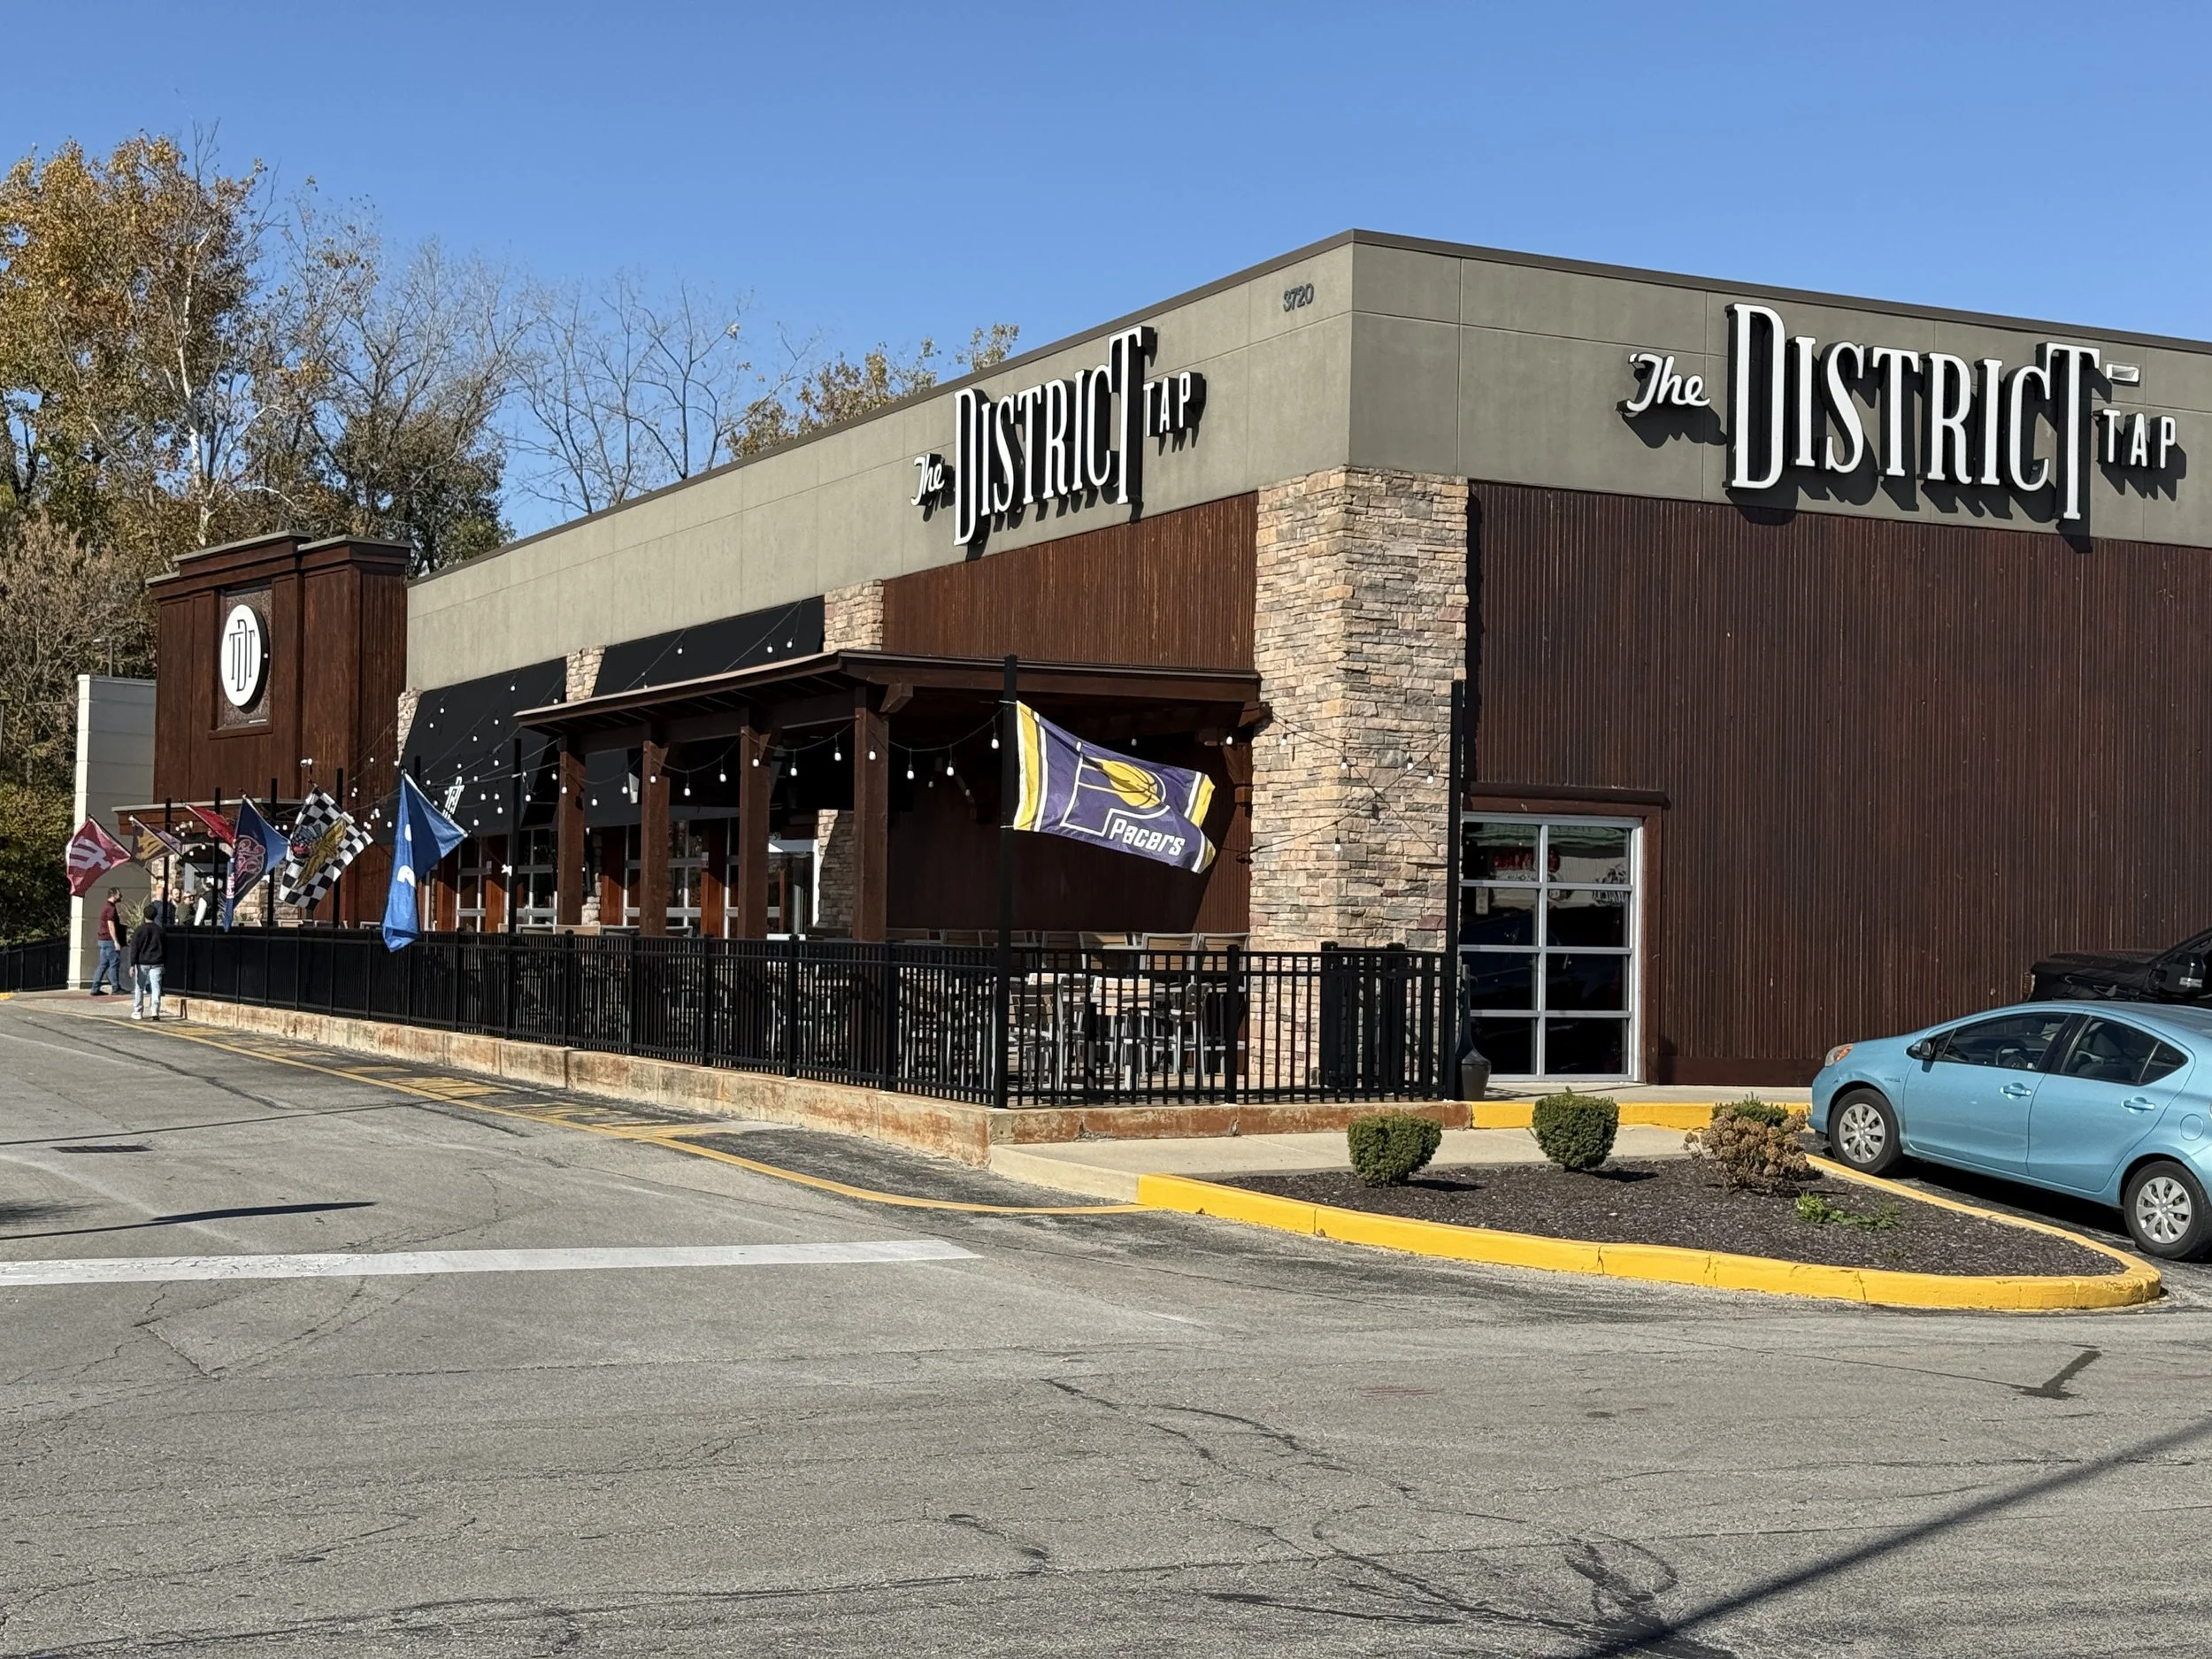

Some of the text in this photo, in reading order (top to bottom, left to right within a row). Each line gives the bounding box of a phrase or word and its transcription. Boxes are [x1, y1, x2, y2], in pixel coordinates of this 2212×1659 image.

[1283, 283, 1314, 312] 3720
[911, 453, 945, 505] The
[1143, 371, 1191, 437] TAP
[1626, 353, 1710, 412] The
[2103, 409, 2176, 469] TAP
[1109, 818, 1186, 856] Pacers
